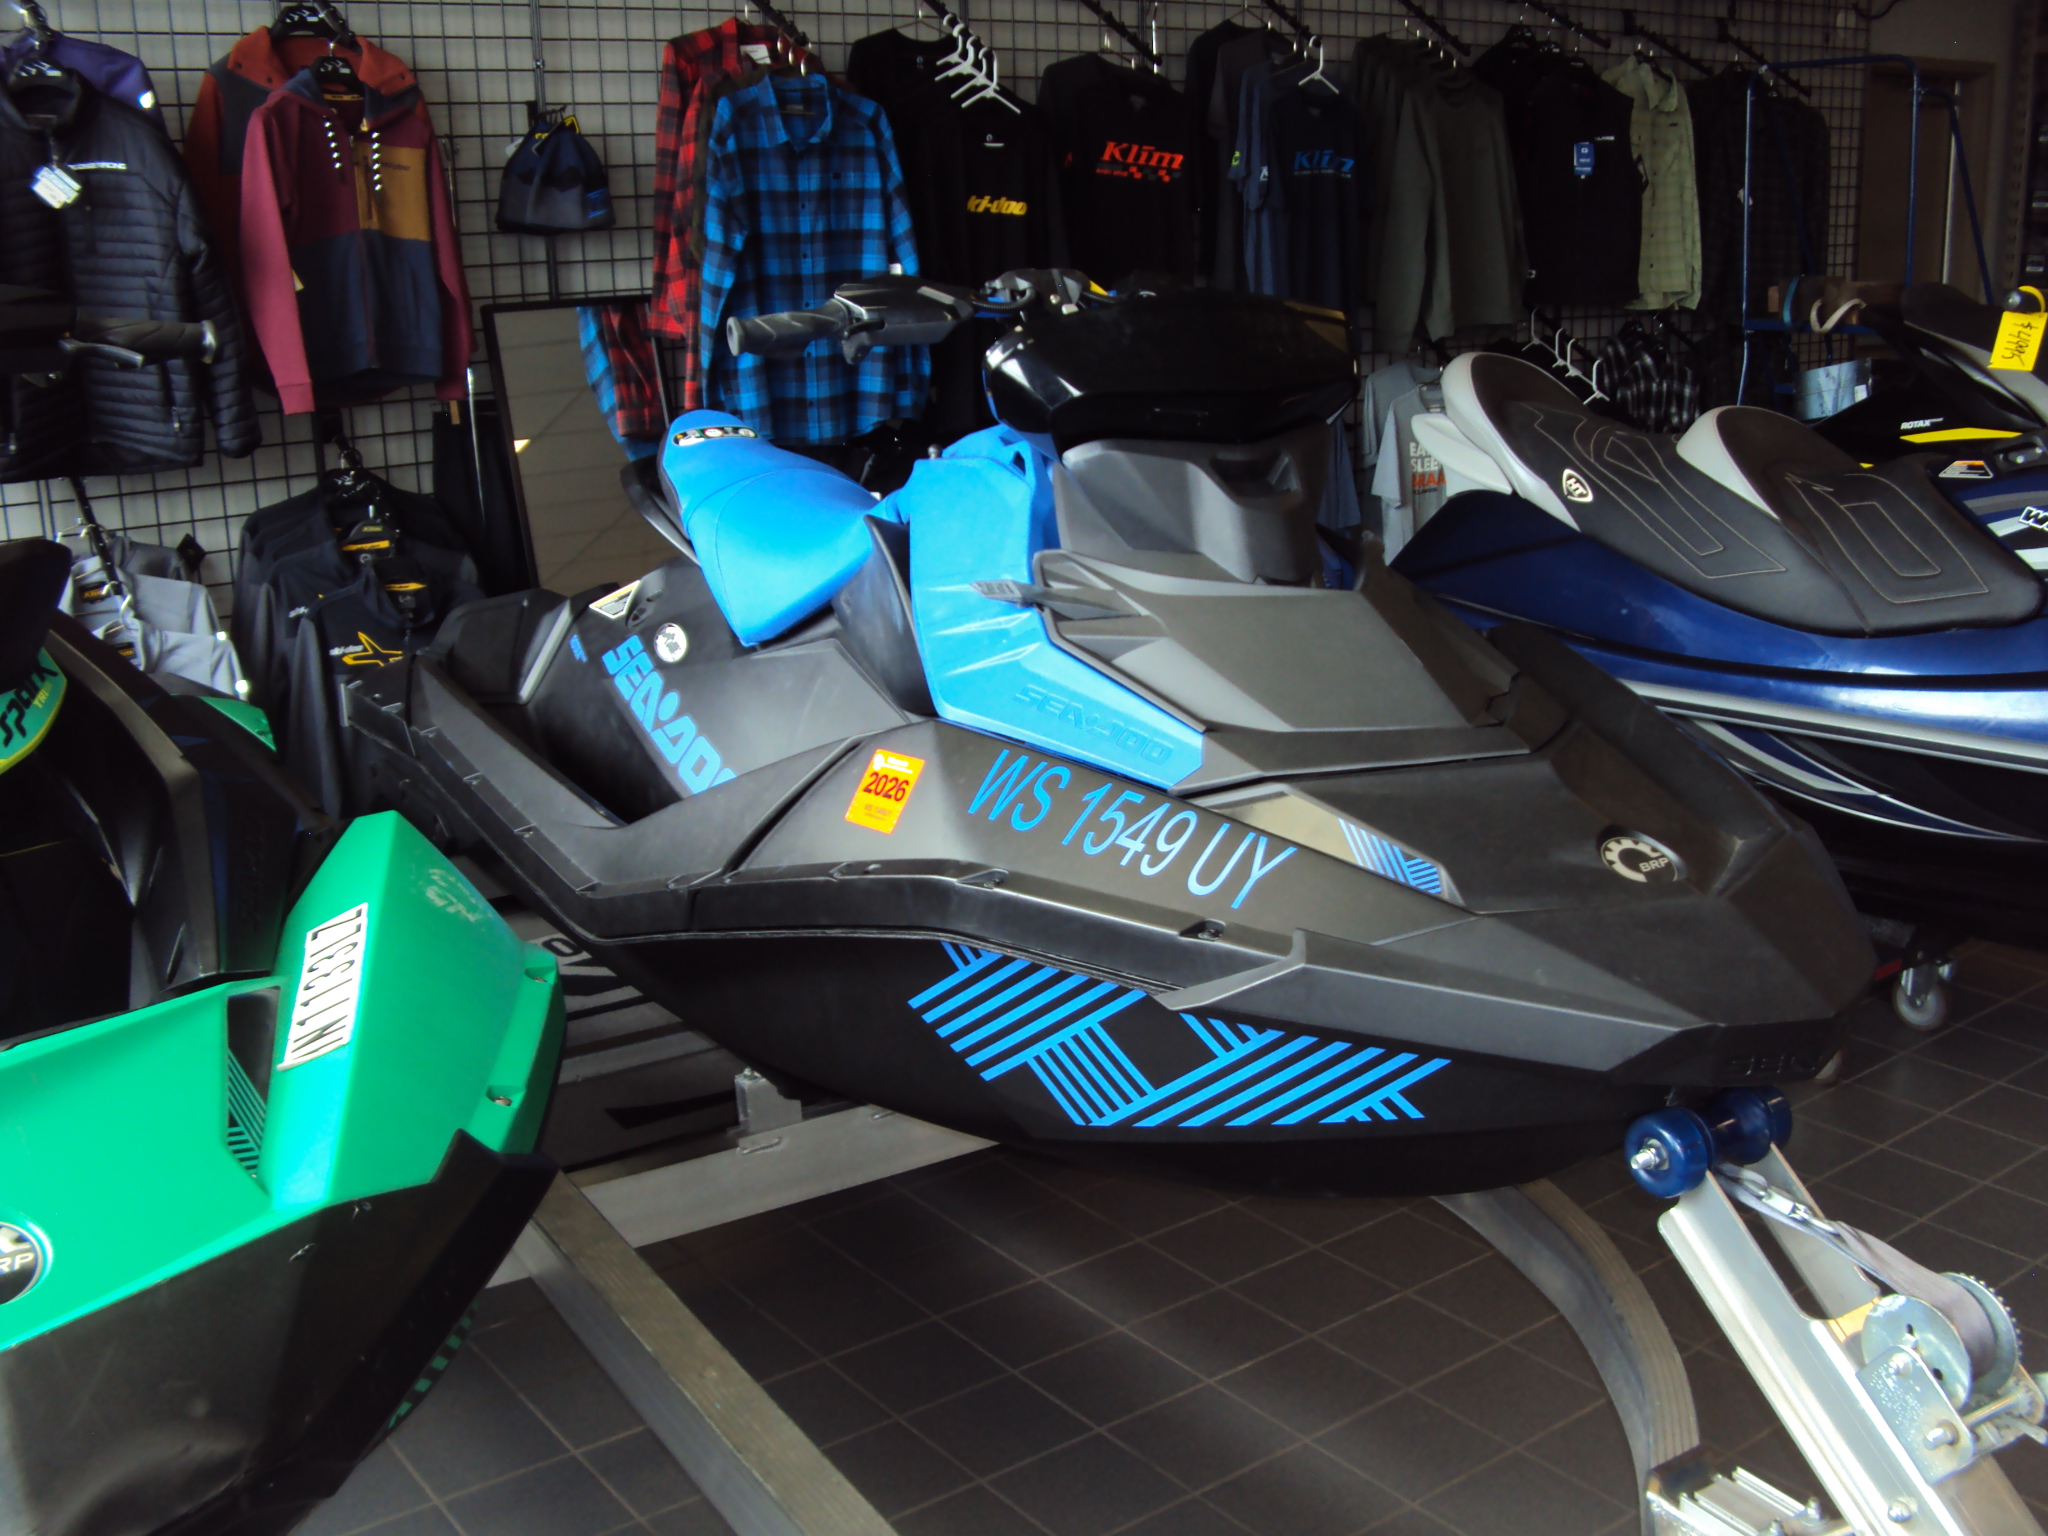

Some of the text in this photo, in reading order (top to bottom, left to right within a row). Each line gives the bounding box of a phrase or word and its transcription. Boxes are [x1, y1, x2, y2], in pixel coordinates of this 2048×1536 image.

[1900, 418, 1931, 430] ROTAX
[1409, 441, 1431, 458] EA
[1410, 456, 1442, 473] SLEE
[863, 772, 909, 802] 2026
[967, 749, 1298, 910] WS 1549 UY
[1639, 857, 1669, 873] BRP
